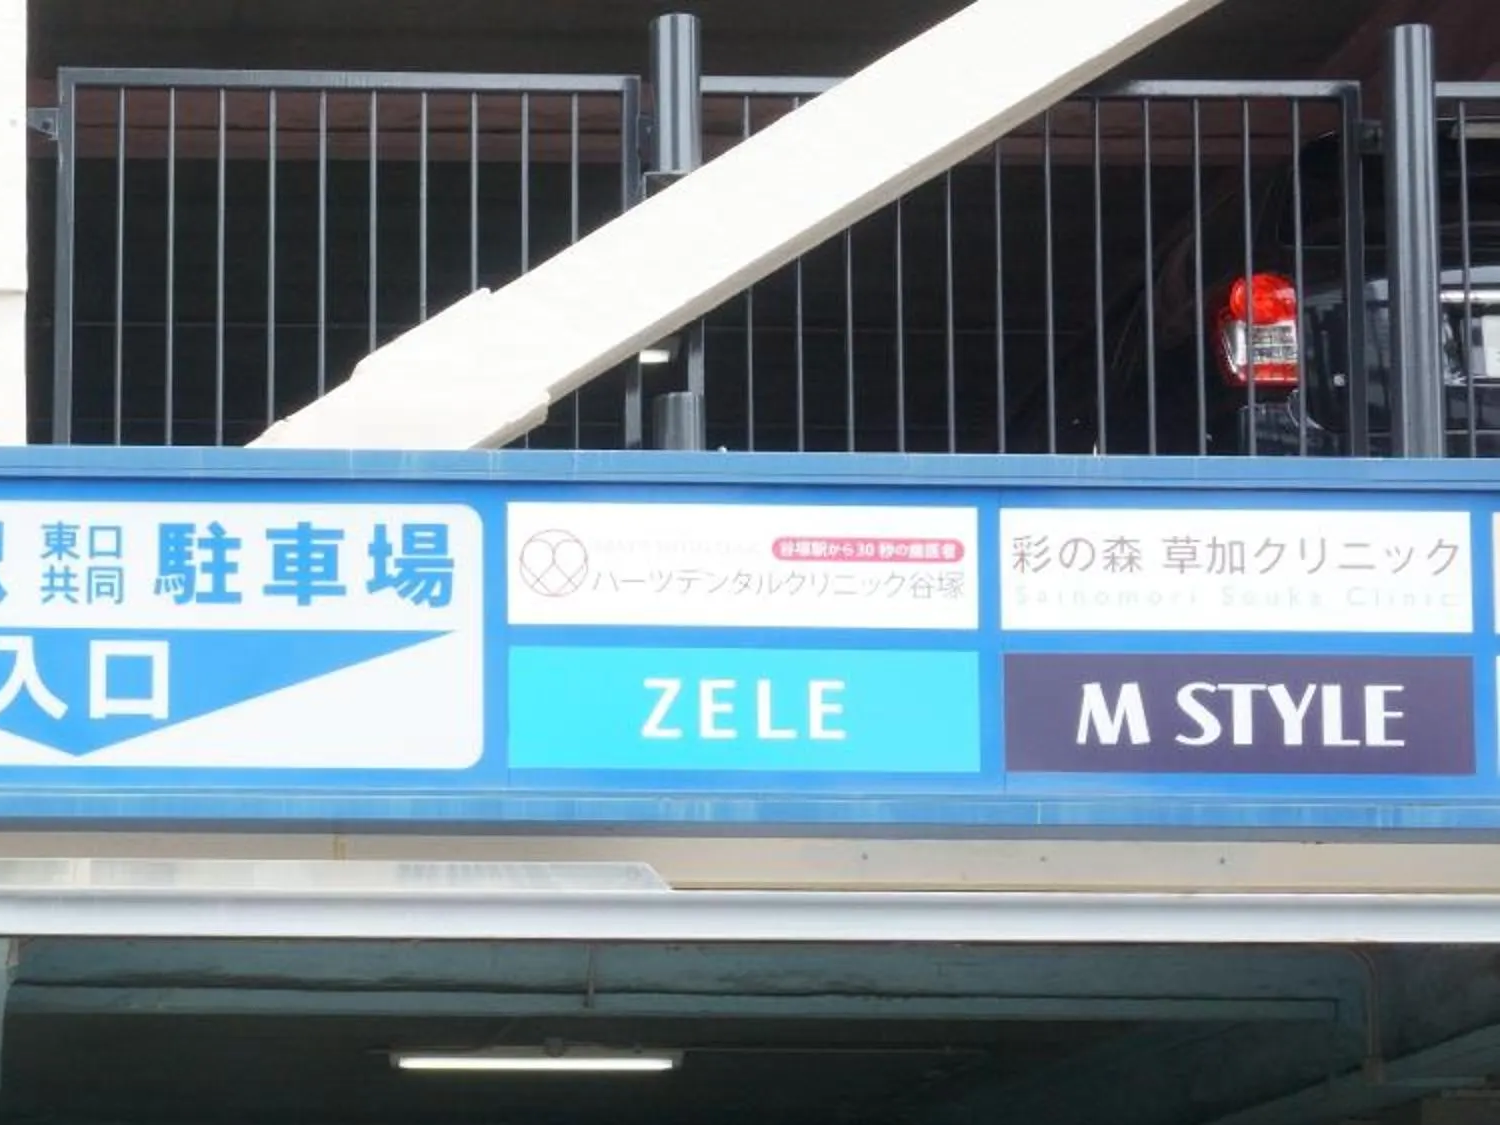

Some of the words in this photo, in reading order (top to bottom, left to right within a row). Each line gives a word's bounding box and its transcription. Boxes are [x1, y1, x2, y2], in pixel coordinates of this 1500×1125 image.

[41, 521, 122, 560] 東口
[153, 521, 455, 607] 駐車場
[1012, 535, 1143, 575] 彩の森
[1161, 535, 1460, 576] 草加クリニック
[40, 565, 124, 605] 共同
[591, 568, 966, 600] ハーツデンタルクリニック谷塚
[641, 678, 846, 740] ZELE
[1076, 682, 1151, 746] M
[1174, 682, 1406, 747] STYLE
